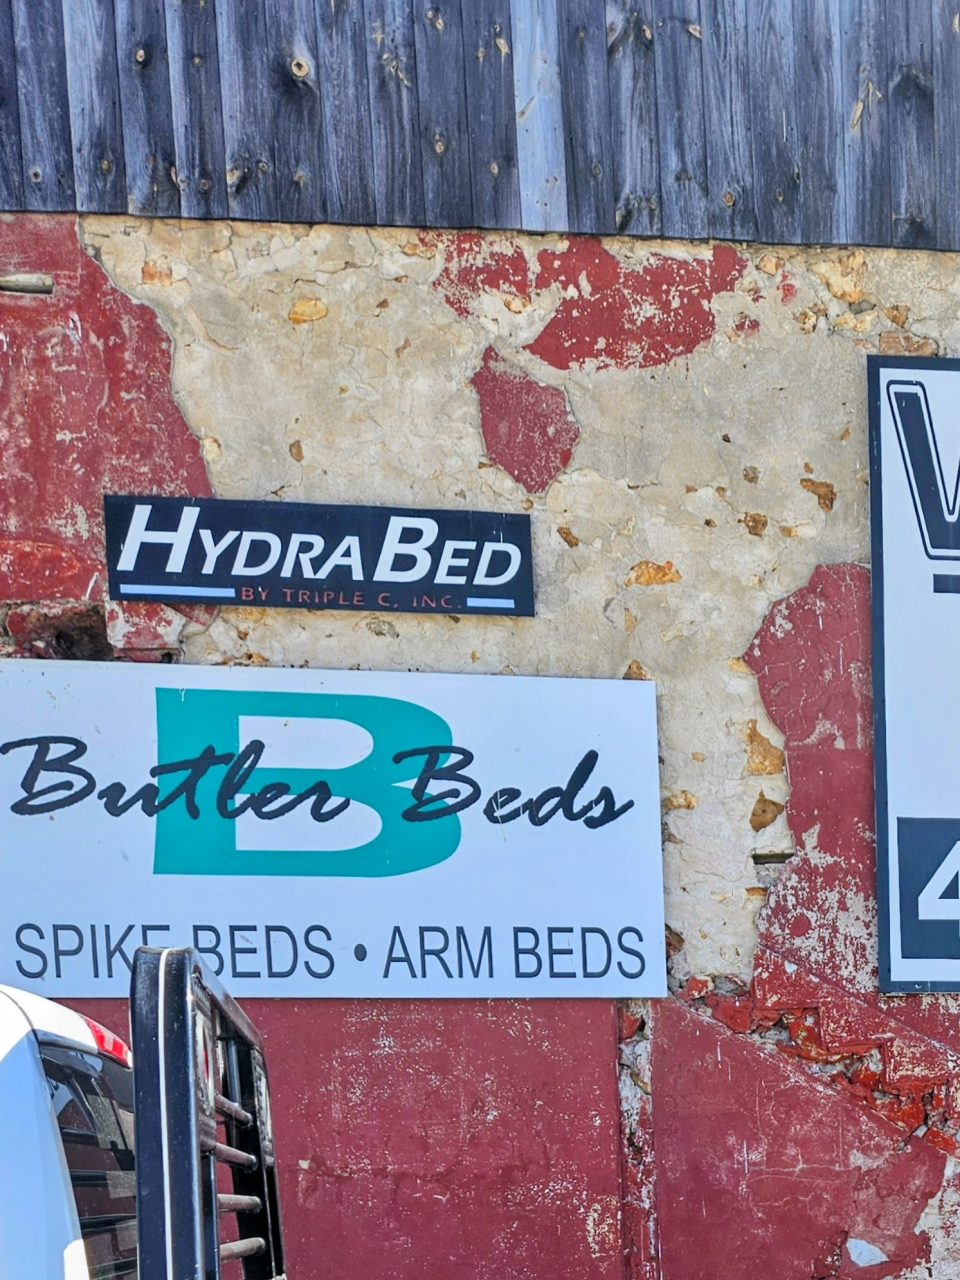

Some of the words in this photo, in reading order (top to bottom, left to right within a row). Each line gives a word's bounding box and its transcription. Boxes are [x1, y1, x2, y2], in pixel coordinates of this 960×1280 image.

[241, 586, 269, 601] BY
[282, 588, 364, 606] TRIPLE
[412, 593, 462, 609] INC.
[0, 735, 350, 822] Butler
[393, 744, 635, 829] Beds
[193, 923, 335, 980] BEDS
[383, 925, 494, 979] ARM
[513, 925, 646, 980] BEDS
